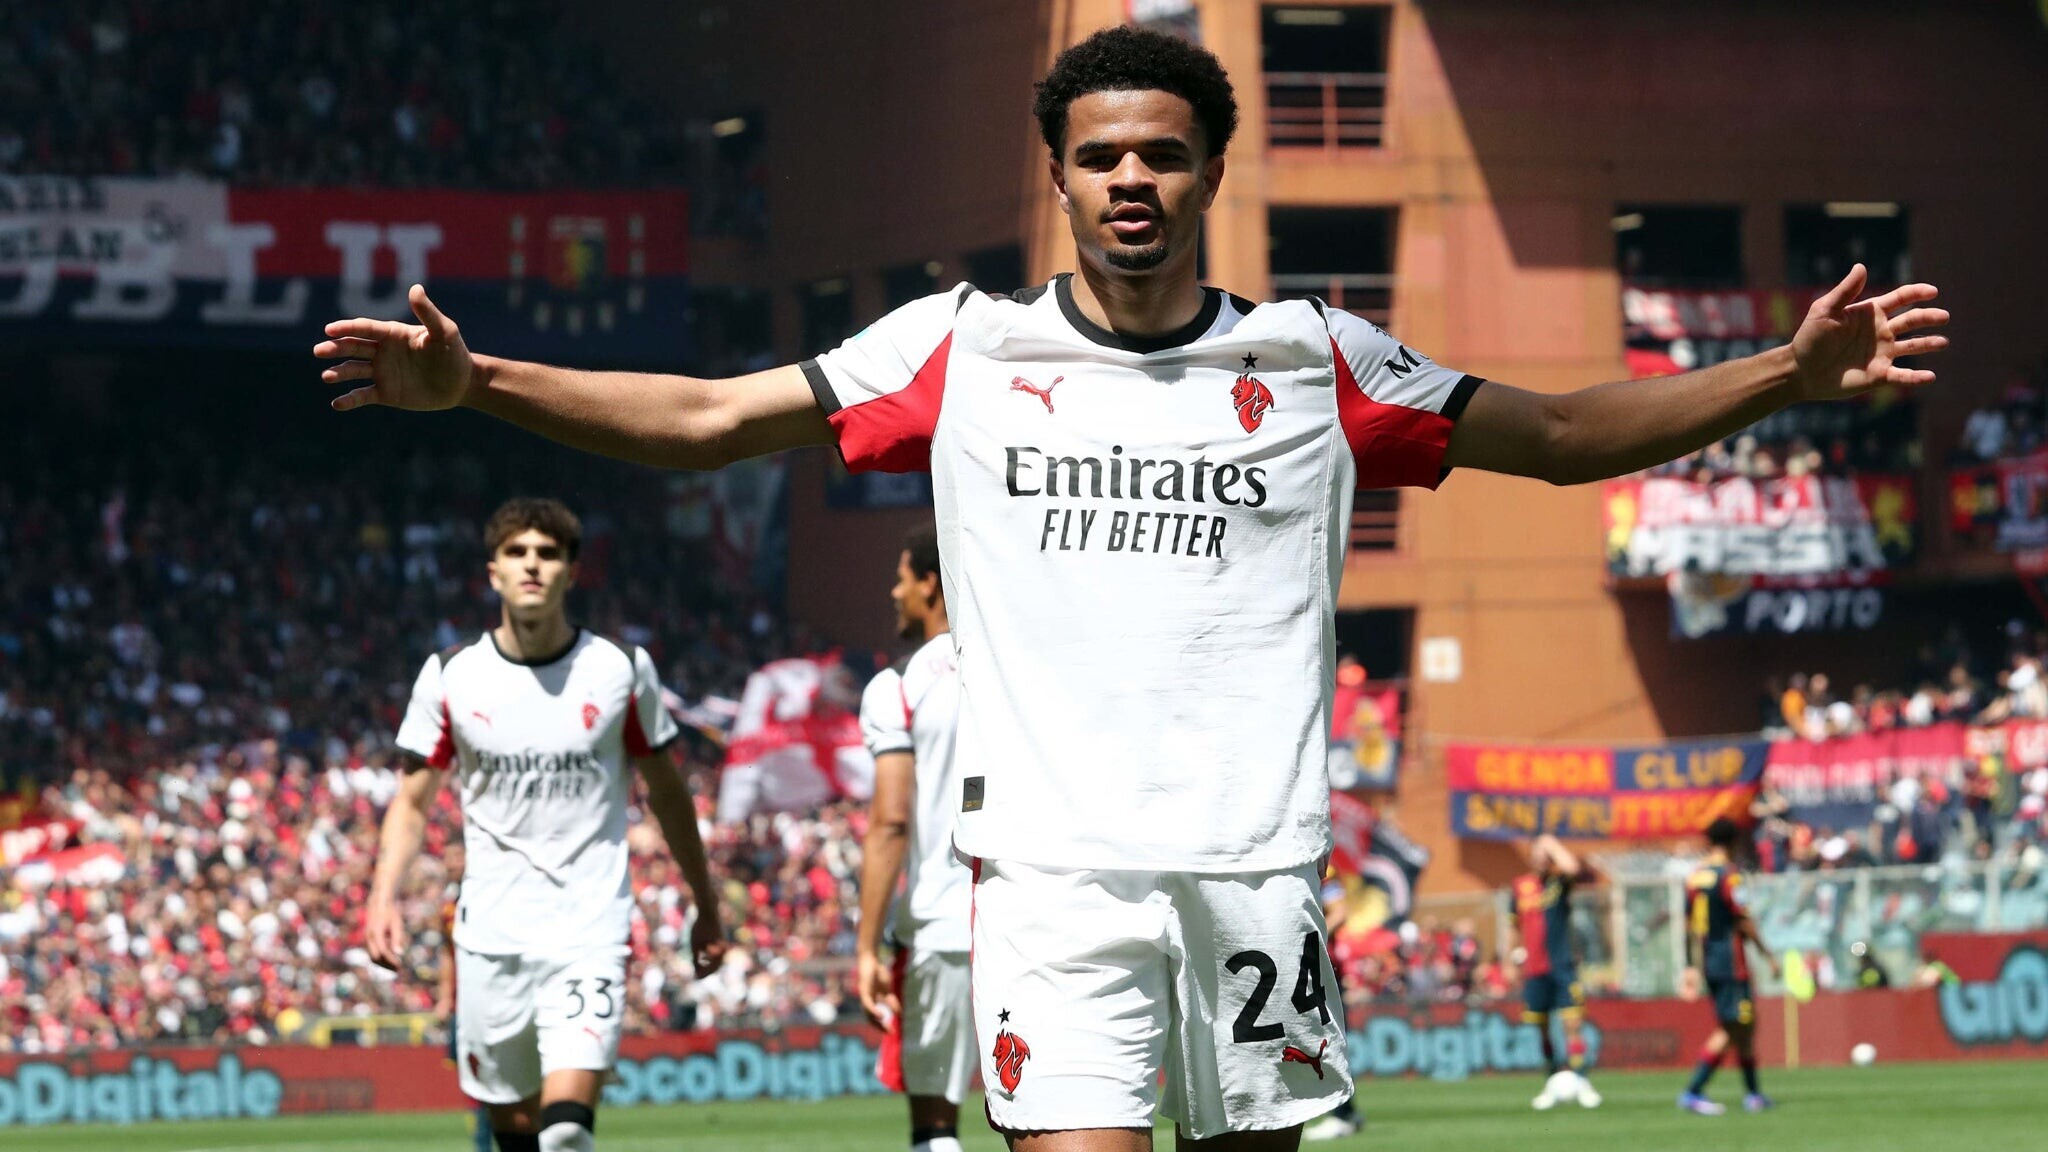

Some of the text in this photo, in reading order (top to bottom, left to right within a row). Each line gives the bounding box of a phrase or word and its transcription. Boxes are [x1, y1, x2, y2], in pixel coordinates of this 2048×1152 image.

[1005, 446, 1268, 508] Emirates
[1041, 509, 1228, 558] FLY BETTER
[1744, 589, 1882, 634] PORTO
[1475, 751, 1611, 791] GENOA
[566, 977, 614, 1019] 33
[1225, 930, 1331, 1043] 24
